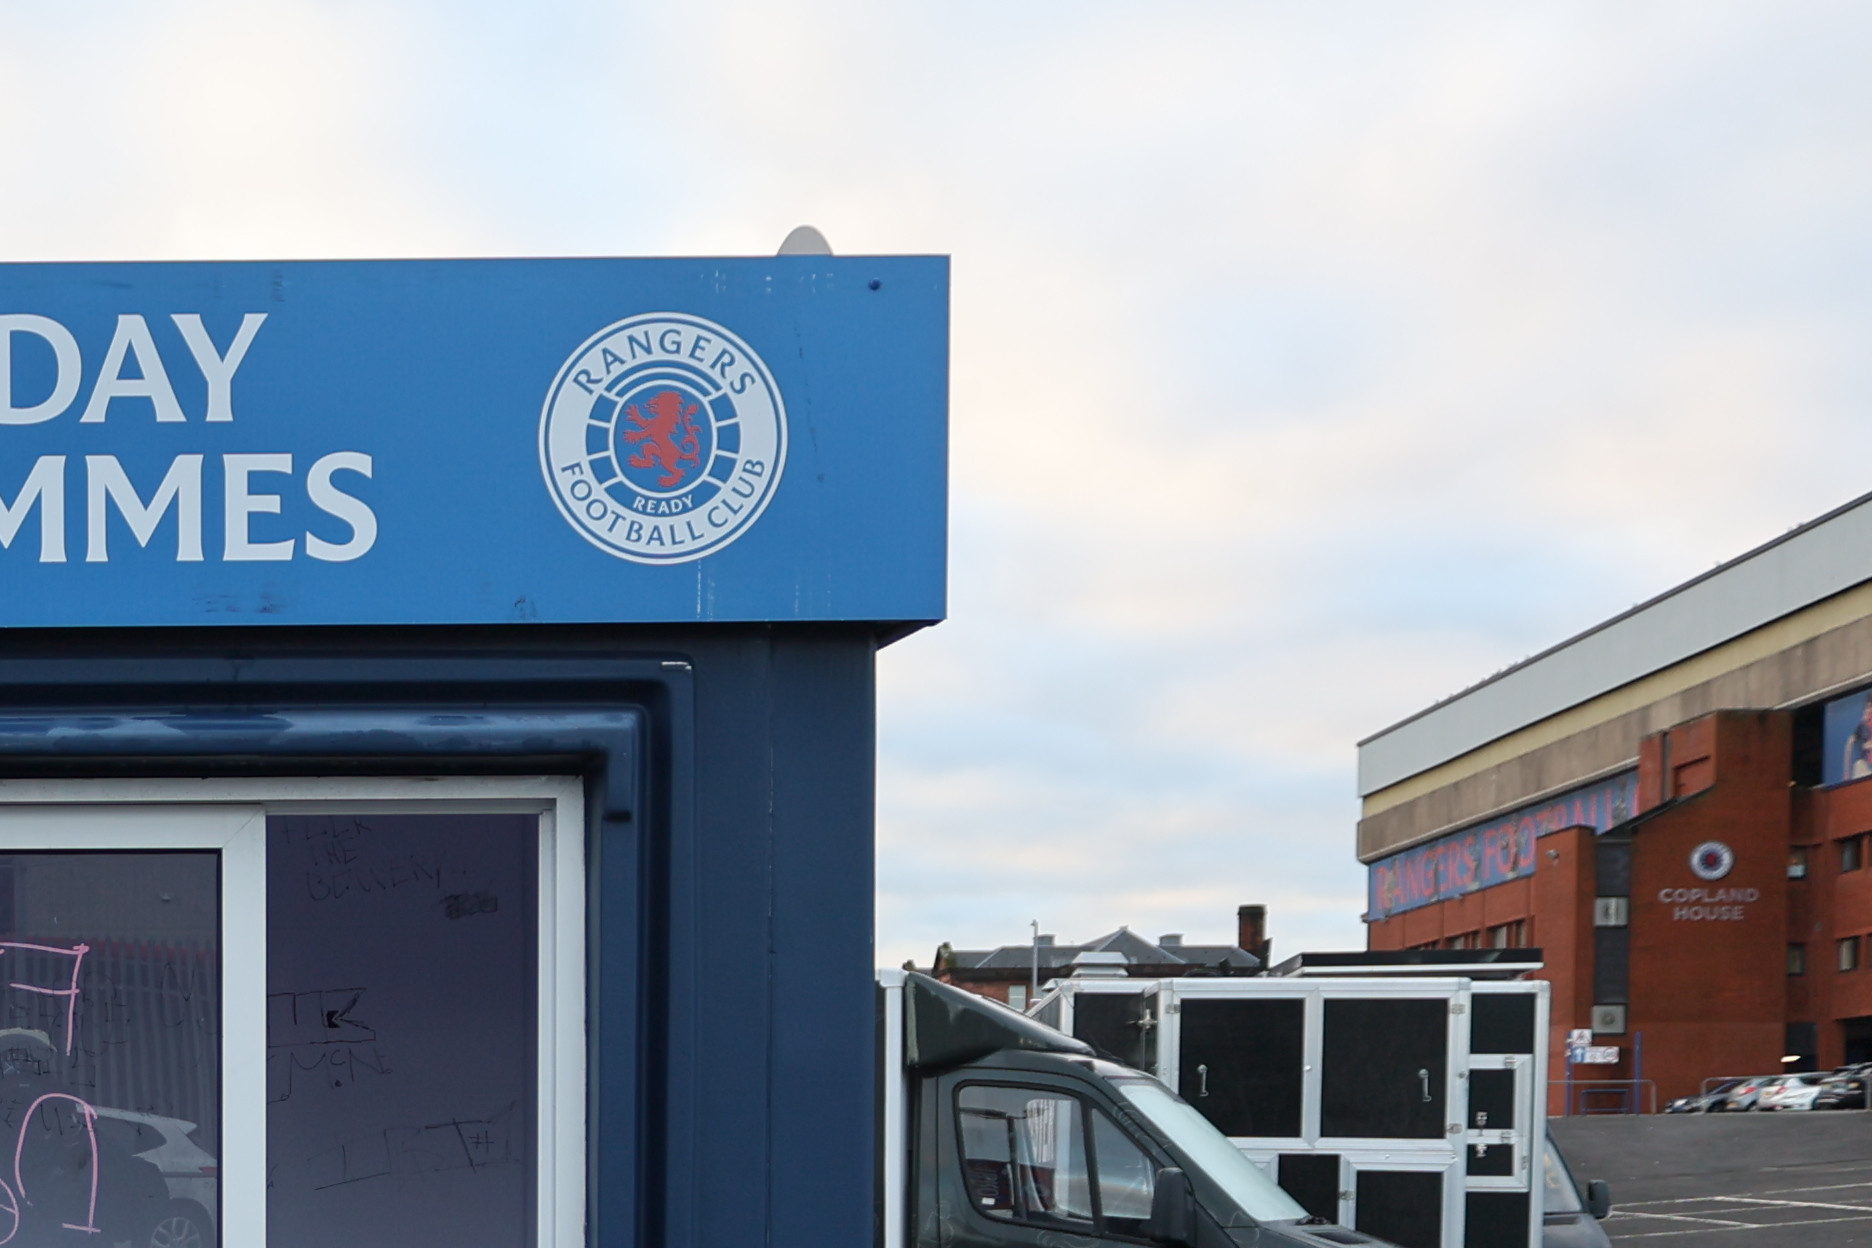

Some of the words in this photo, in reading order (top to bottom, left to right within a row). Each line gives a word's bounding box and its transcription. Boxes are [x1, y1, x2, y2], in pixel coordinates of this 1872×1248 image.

[572, 329, 756, 397] RANGERS
[560, 461, 705, 547] FOOTBALL
[706, 457, 766, 530] CLUB
[633, 494, 694, 516] READY
[1658, 887, 1760, 903] COPLAND
[1673, 905, 1744, 920] HOUSE
